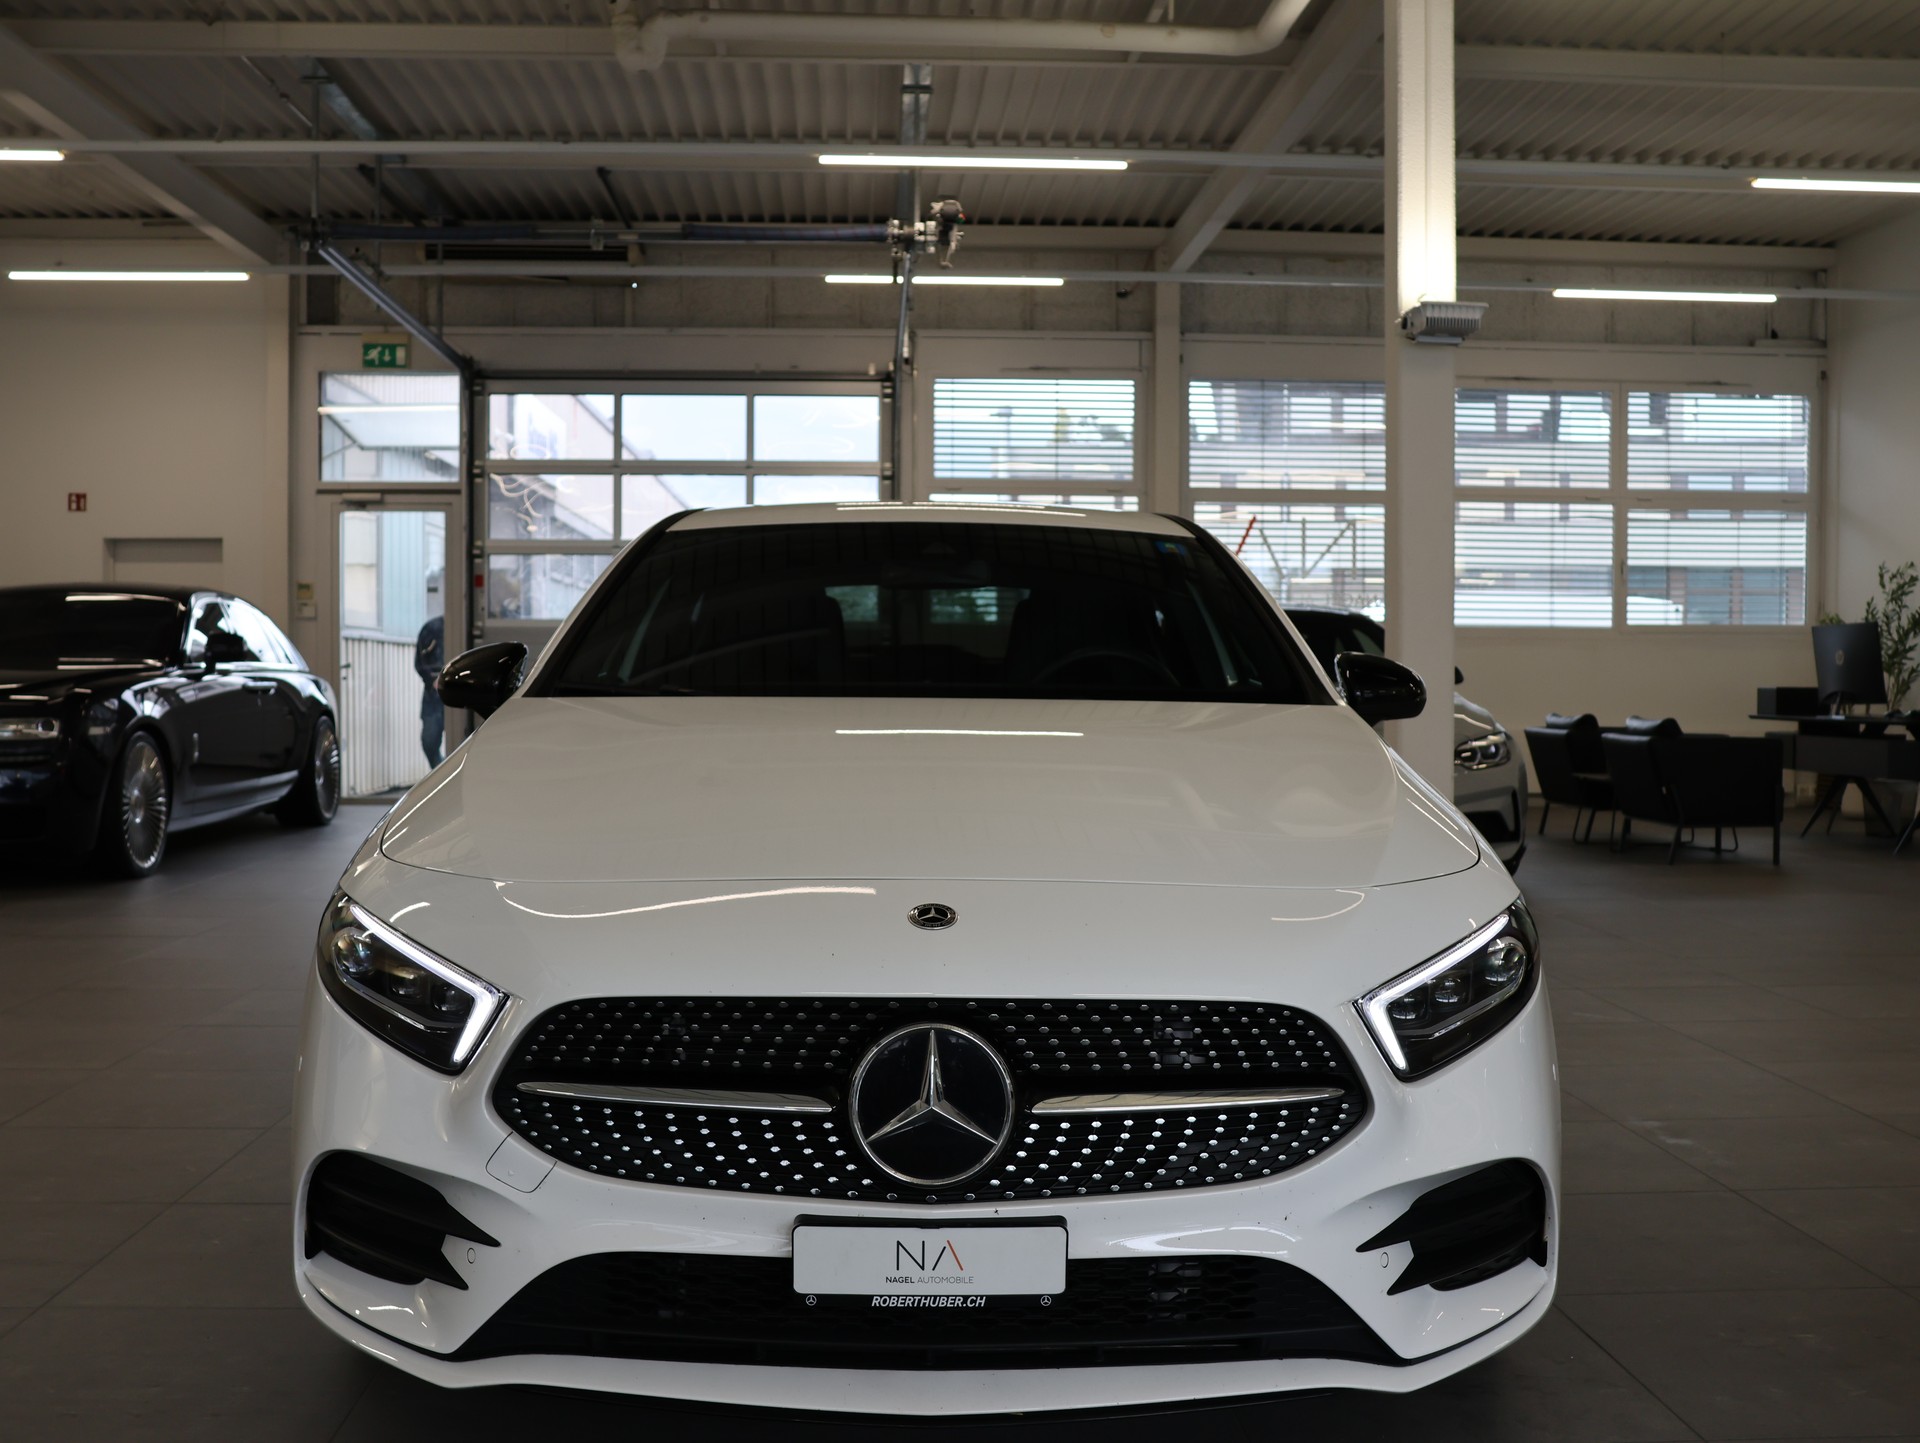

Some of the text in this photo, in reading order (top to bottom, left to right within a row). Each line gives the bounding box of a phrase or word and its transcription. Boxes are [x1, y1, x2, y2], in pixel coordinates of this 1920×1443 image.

[885, 1276, 975, 1284] NAGEL AUTOMOBILE
[871, 1296, 986, 1307] ROBERTHUBER.CH
